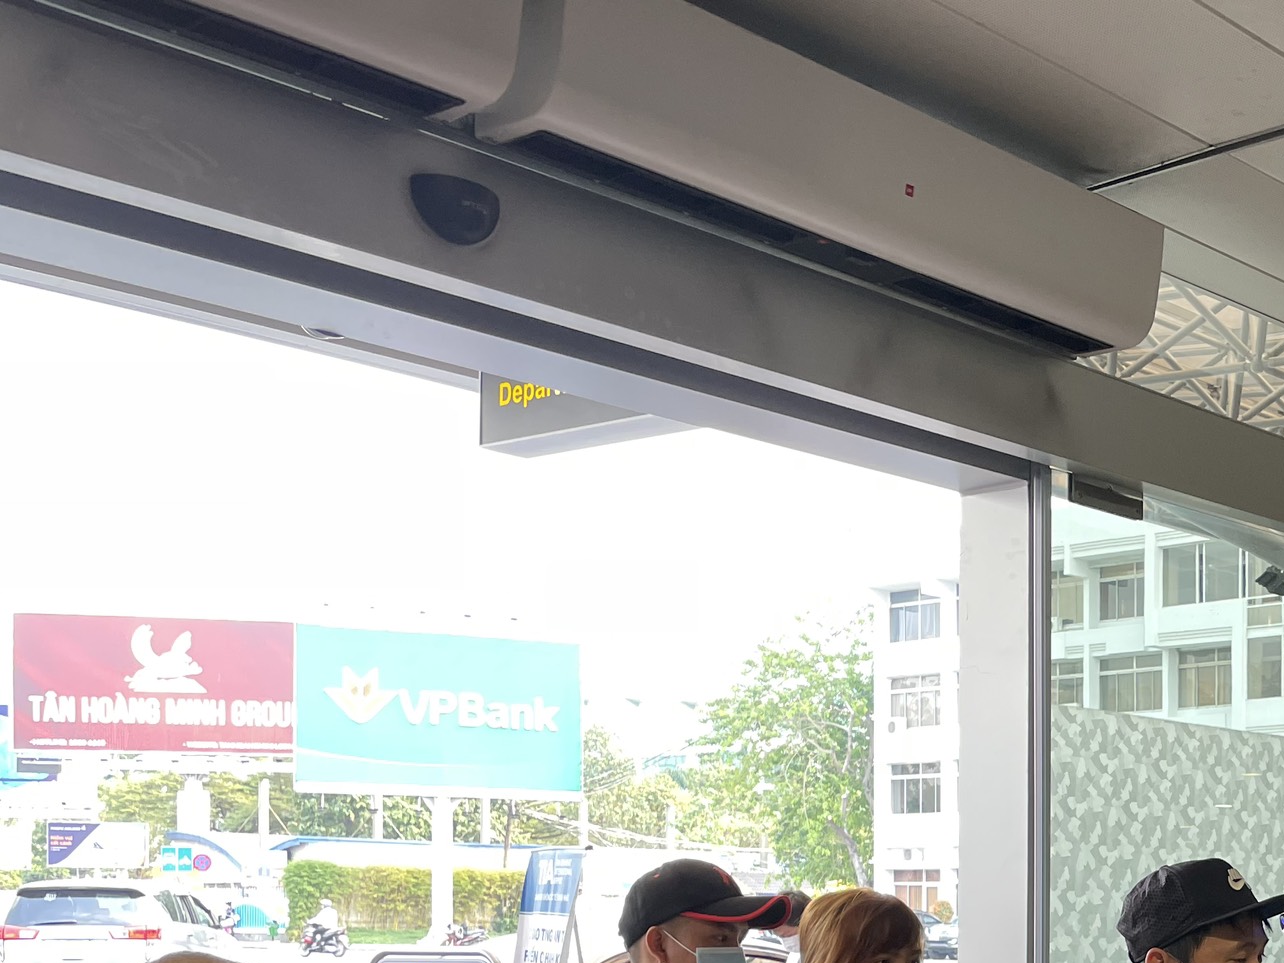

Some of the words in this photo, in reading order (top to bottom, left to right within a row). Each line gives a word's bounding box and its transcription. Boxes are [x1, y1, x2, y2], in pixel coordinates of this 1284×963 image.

[28, 690, 76, 723] TÂN
[81, 692, 161, 725] HOÀNG
[165, 698, 226, 726] MINH
[230, 699, 294, 728] GROU
[399, 687, 561, 733] VPBank
